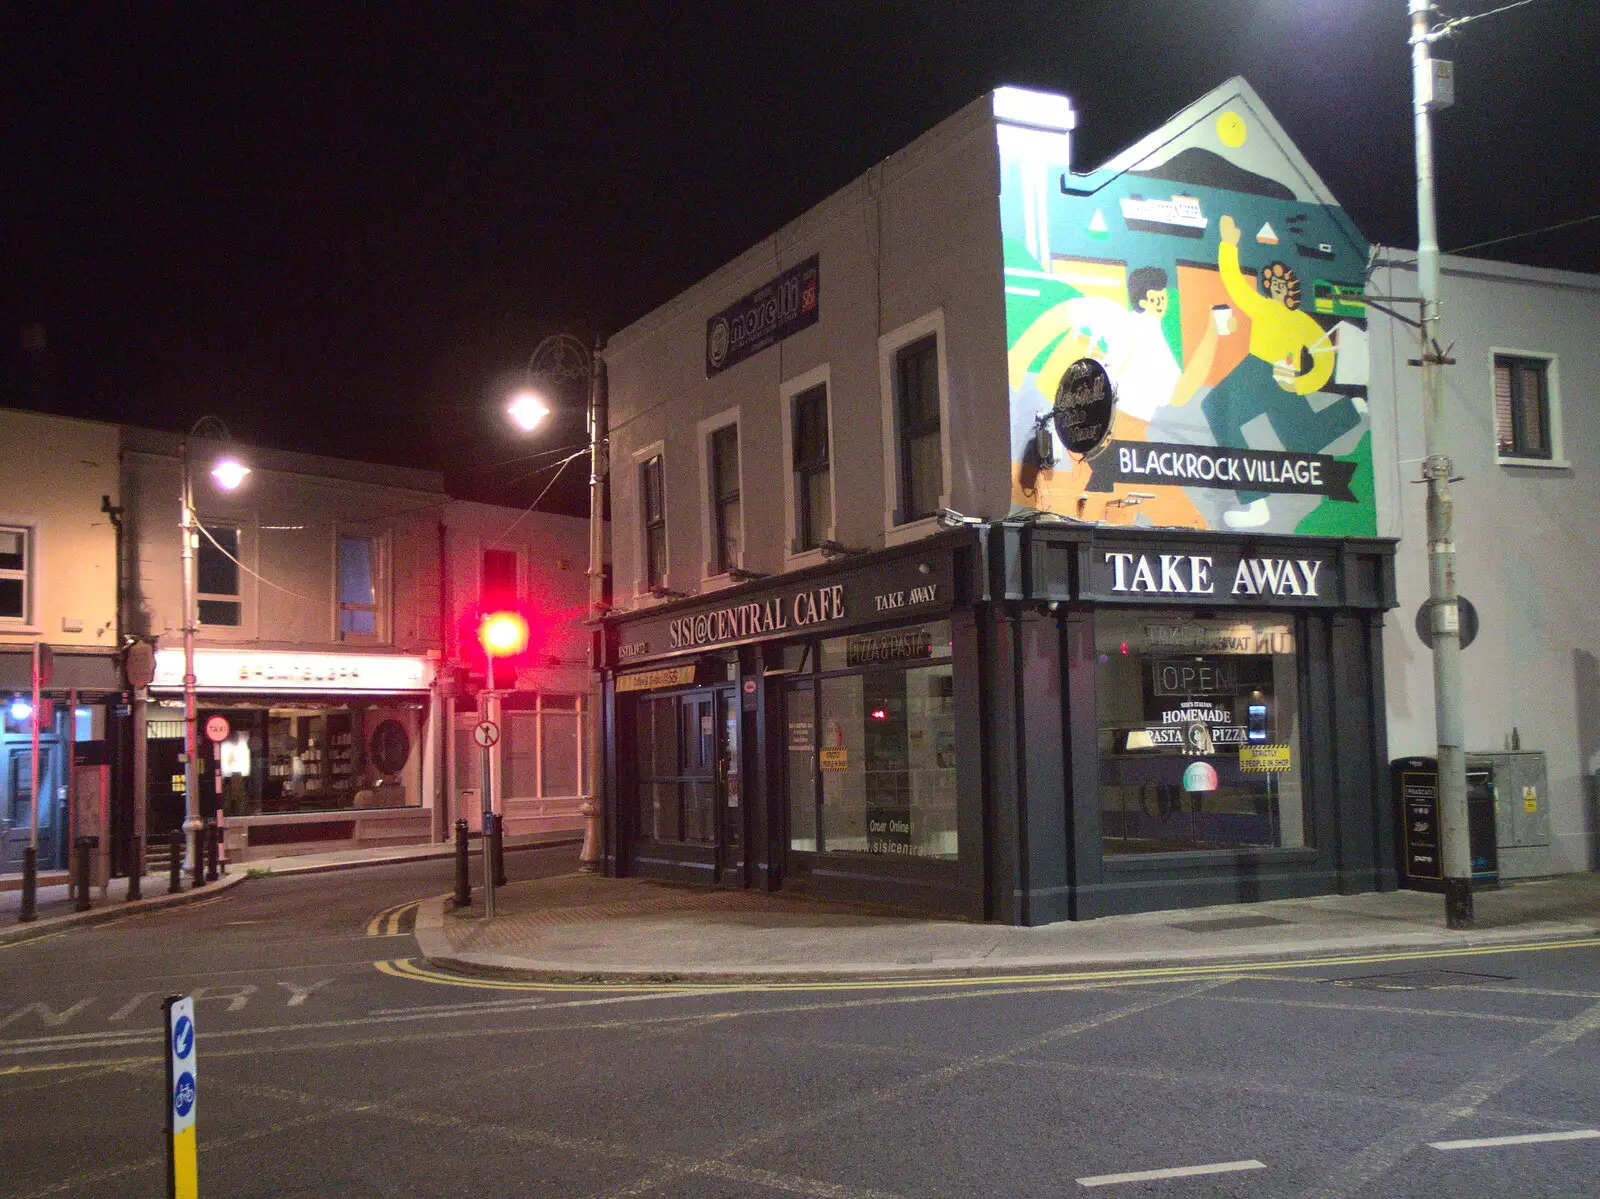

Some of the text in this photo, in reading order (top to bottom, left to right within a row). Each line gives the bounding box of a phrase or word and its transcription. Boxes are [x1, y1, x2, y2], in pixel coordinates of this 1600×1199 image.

[1119, 447, 1324, 485] BLACKROCK VILLAGE
[1105, 552, 1323, 597] TAKE AWAY
[874, 584, 937, 611] TAKE AWAY
[668, 584, 845, 649] SISI@CENTRAL CAFE
[1163, 666, 1231, 691] OPEN
[1162, 709, 1231, 724] HOMEMADE
[1147, 729, 1183, 742] PASTA
[1212, 729, 1248, 742] PIZZA
[1252, 749, 1277, 758] STRICTLY
[1274, 759, 1289, 767] SHOP
